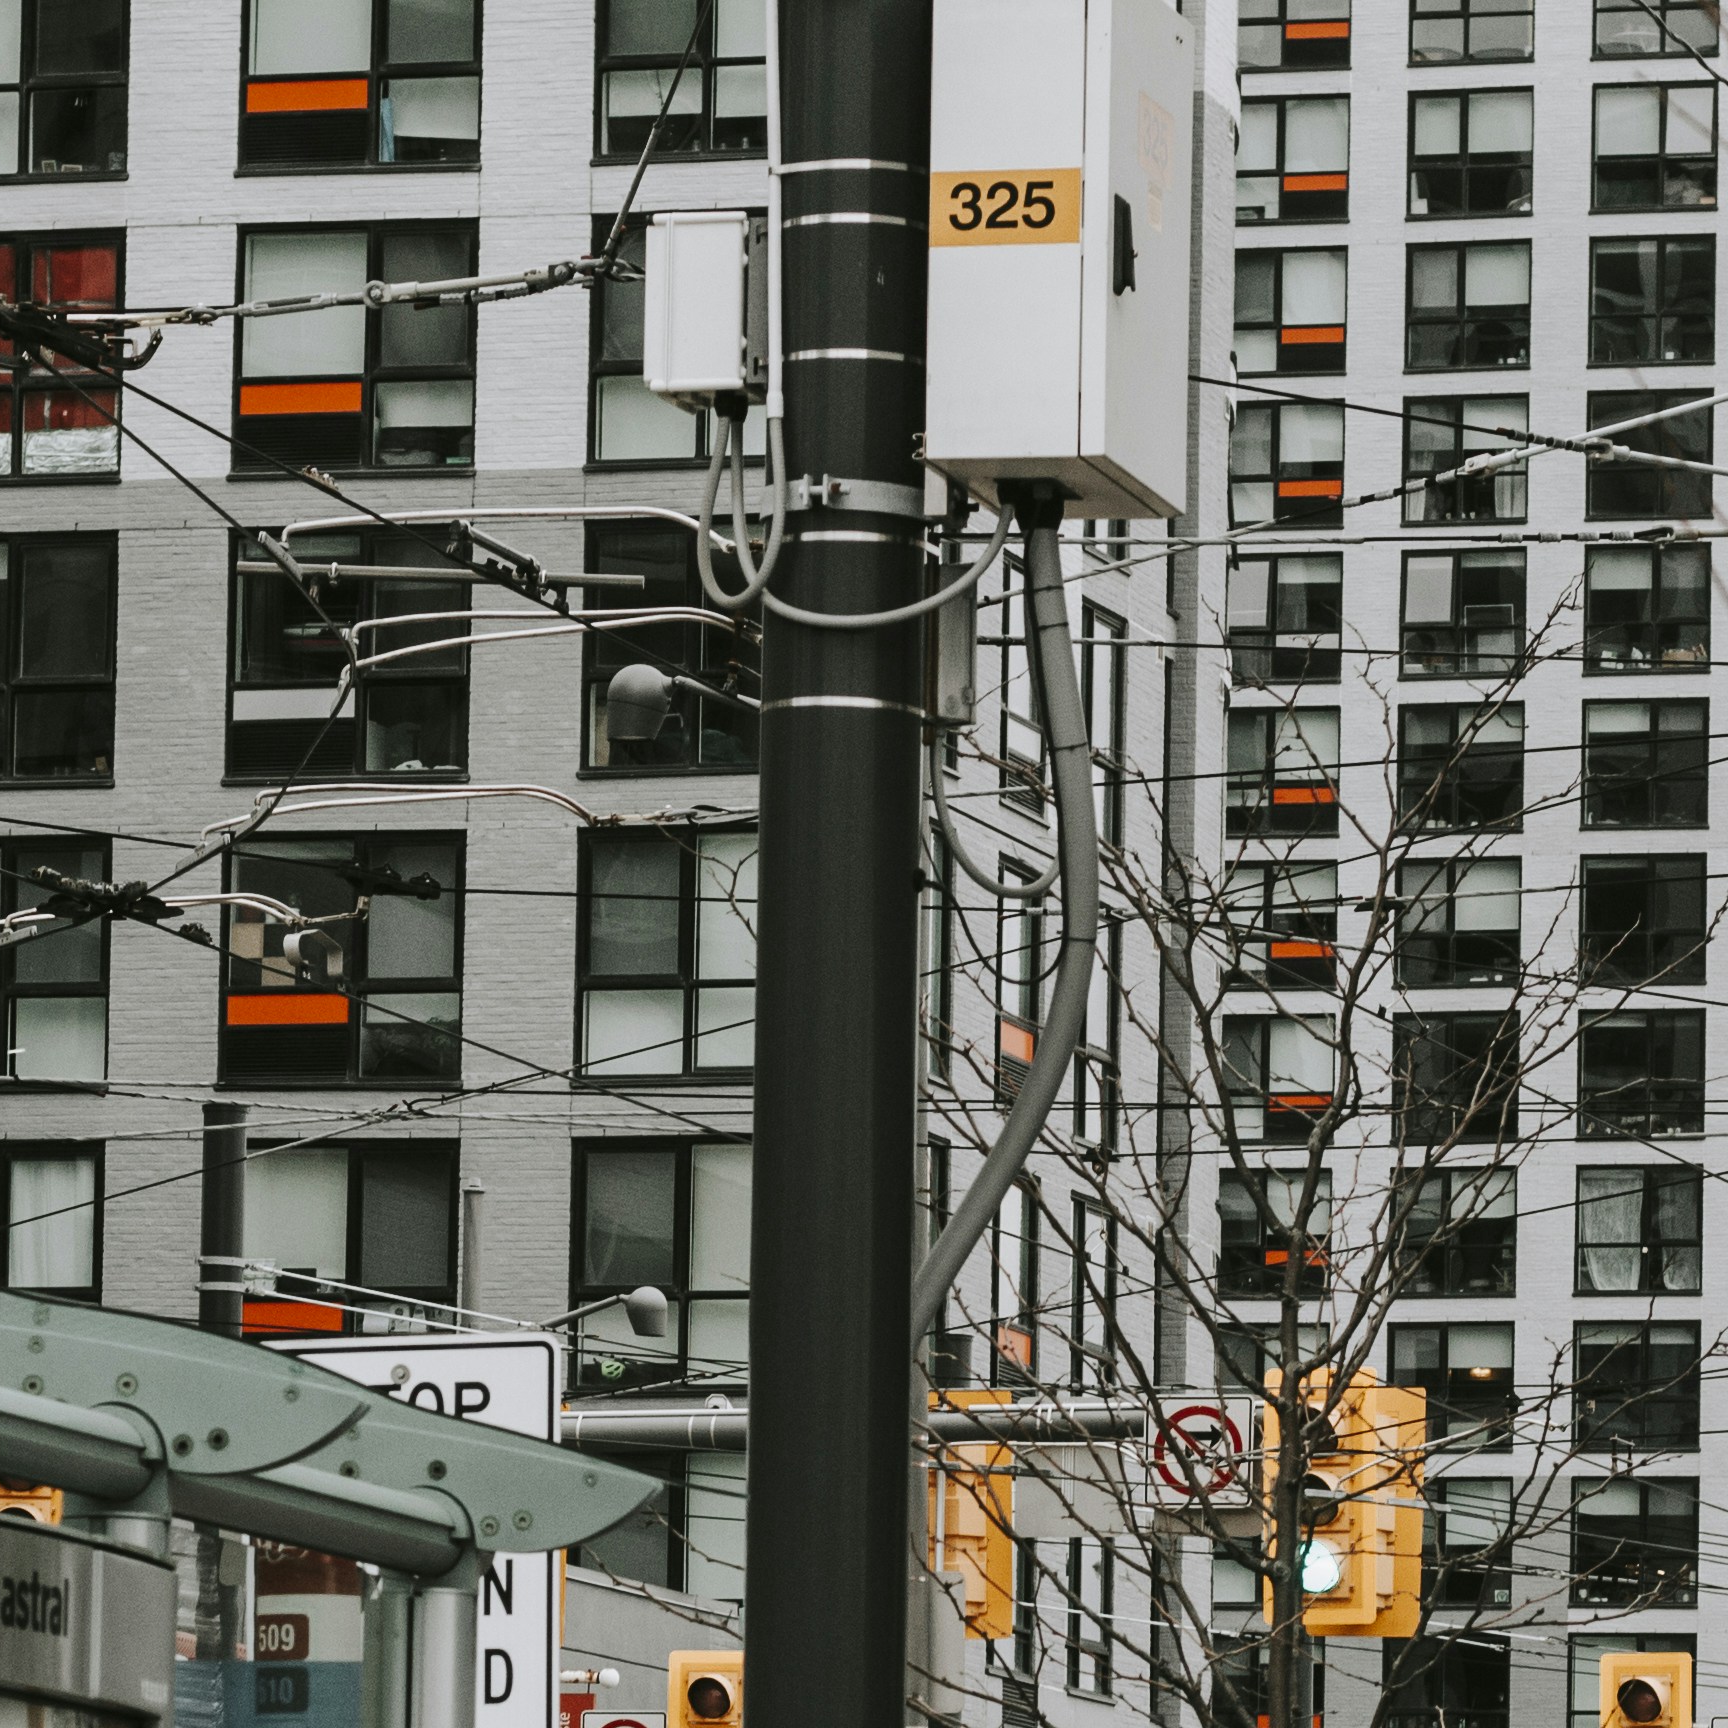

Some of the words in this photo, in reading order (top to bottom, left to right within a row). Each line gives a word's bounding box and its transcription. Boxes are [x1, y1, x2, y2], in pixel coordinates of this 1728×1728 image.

[948, 180, 1056, 231] 325
[366, 1380, 491, 1419] OP
[0, 1571, 69, 1638] astral
[483, 1559, 514, 1616] N
[258, 1623, 296, 1652] 509
